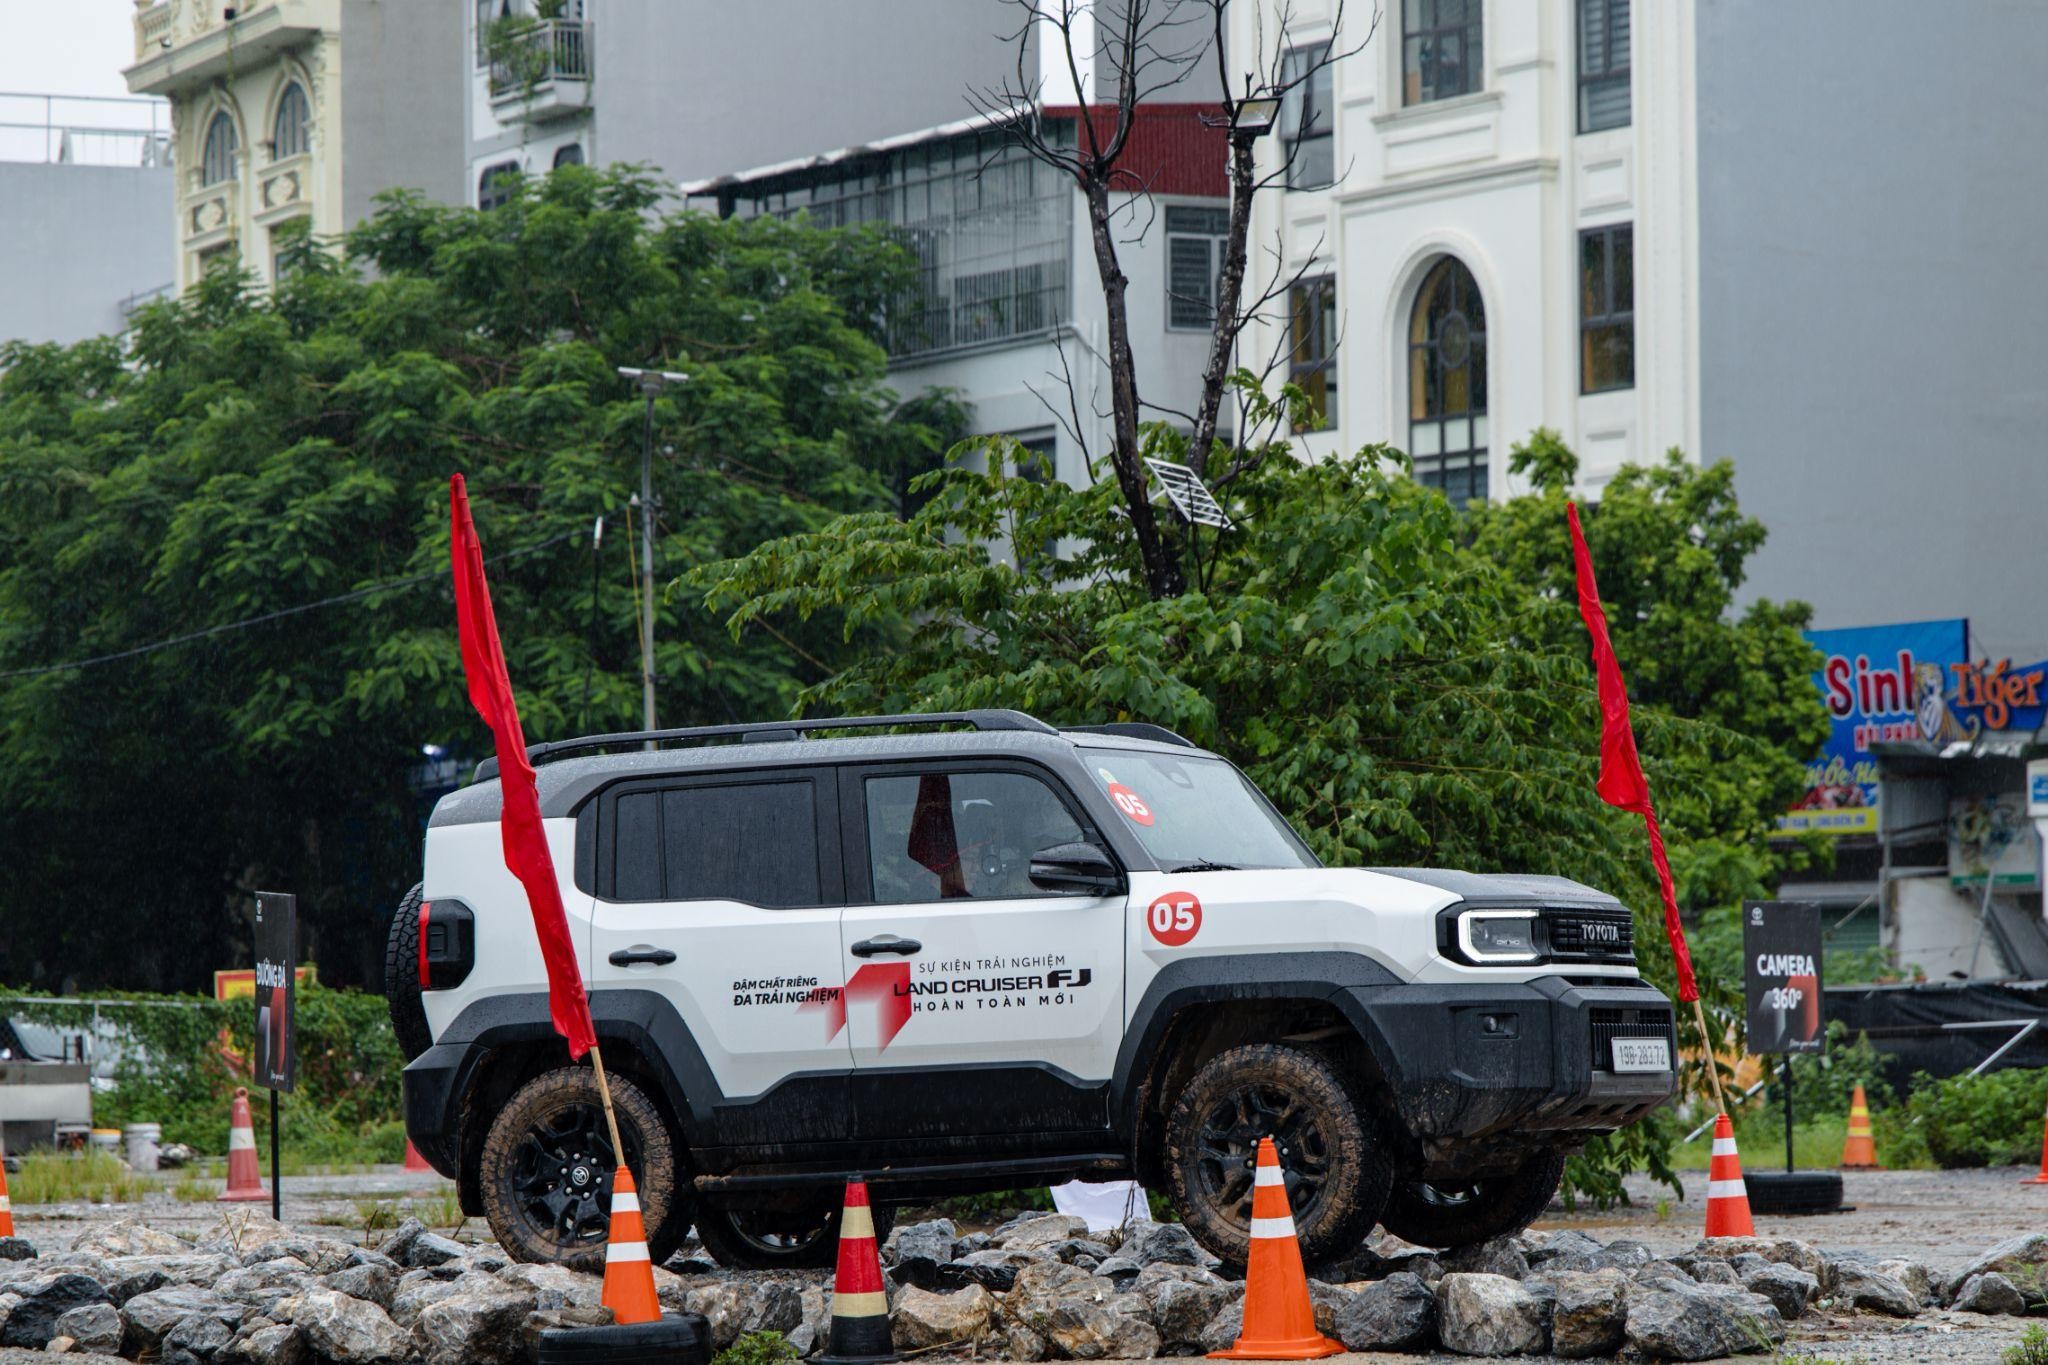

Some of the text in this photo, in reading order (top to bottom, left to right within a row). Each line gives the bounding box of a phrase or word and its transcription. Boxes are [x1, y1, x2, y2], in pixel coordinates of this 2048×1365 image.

[1951, 656, 2045, 730] Tiger
[1114, 792, 1149, 817] 05
[1152, 901, 1195, 933] 05
[1582, 924, 1620, 941] TOYOTA
[919, 954, 1065, 975] SỰ KIỆN TRẢI NGHIỆM
[1756, 953, 1817, 977] CAMERA
[733, 976, 818, 993] ĐẬM CHẤT RIÊNG
[893, 968, 1092, 997] LAND CRUISER FJ
[733, 988, 839, 1006] ĐA TRẢI NGHIỆM
[913, 992, 1073, 1012] HOÀN TOÀN MỚI
